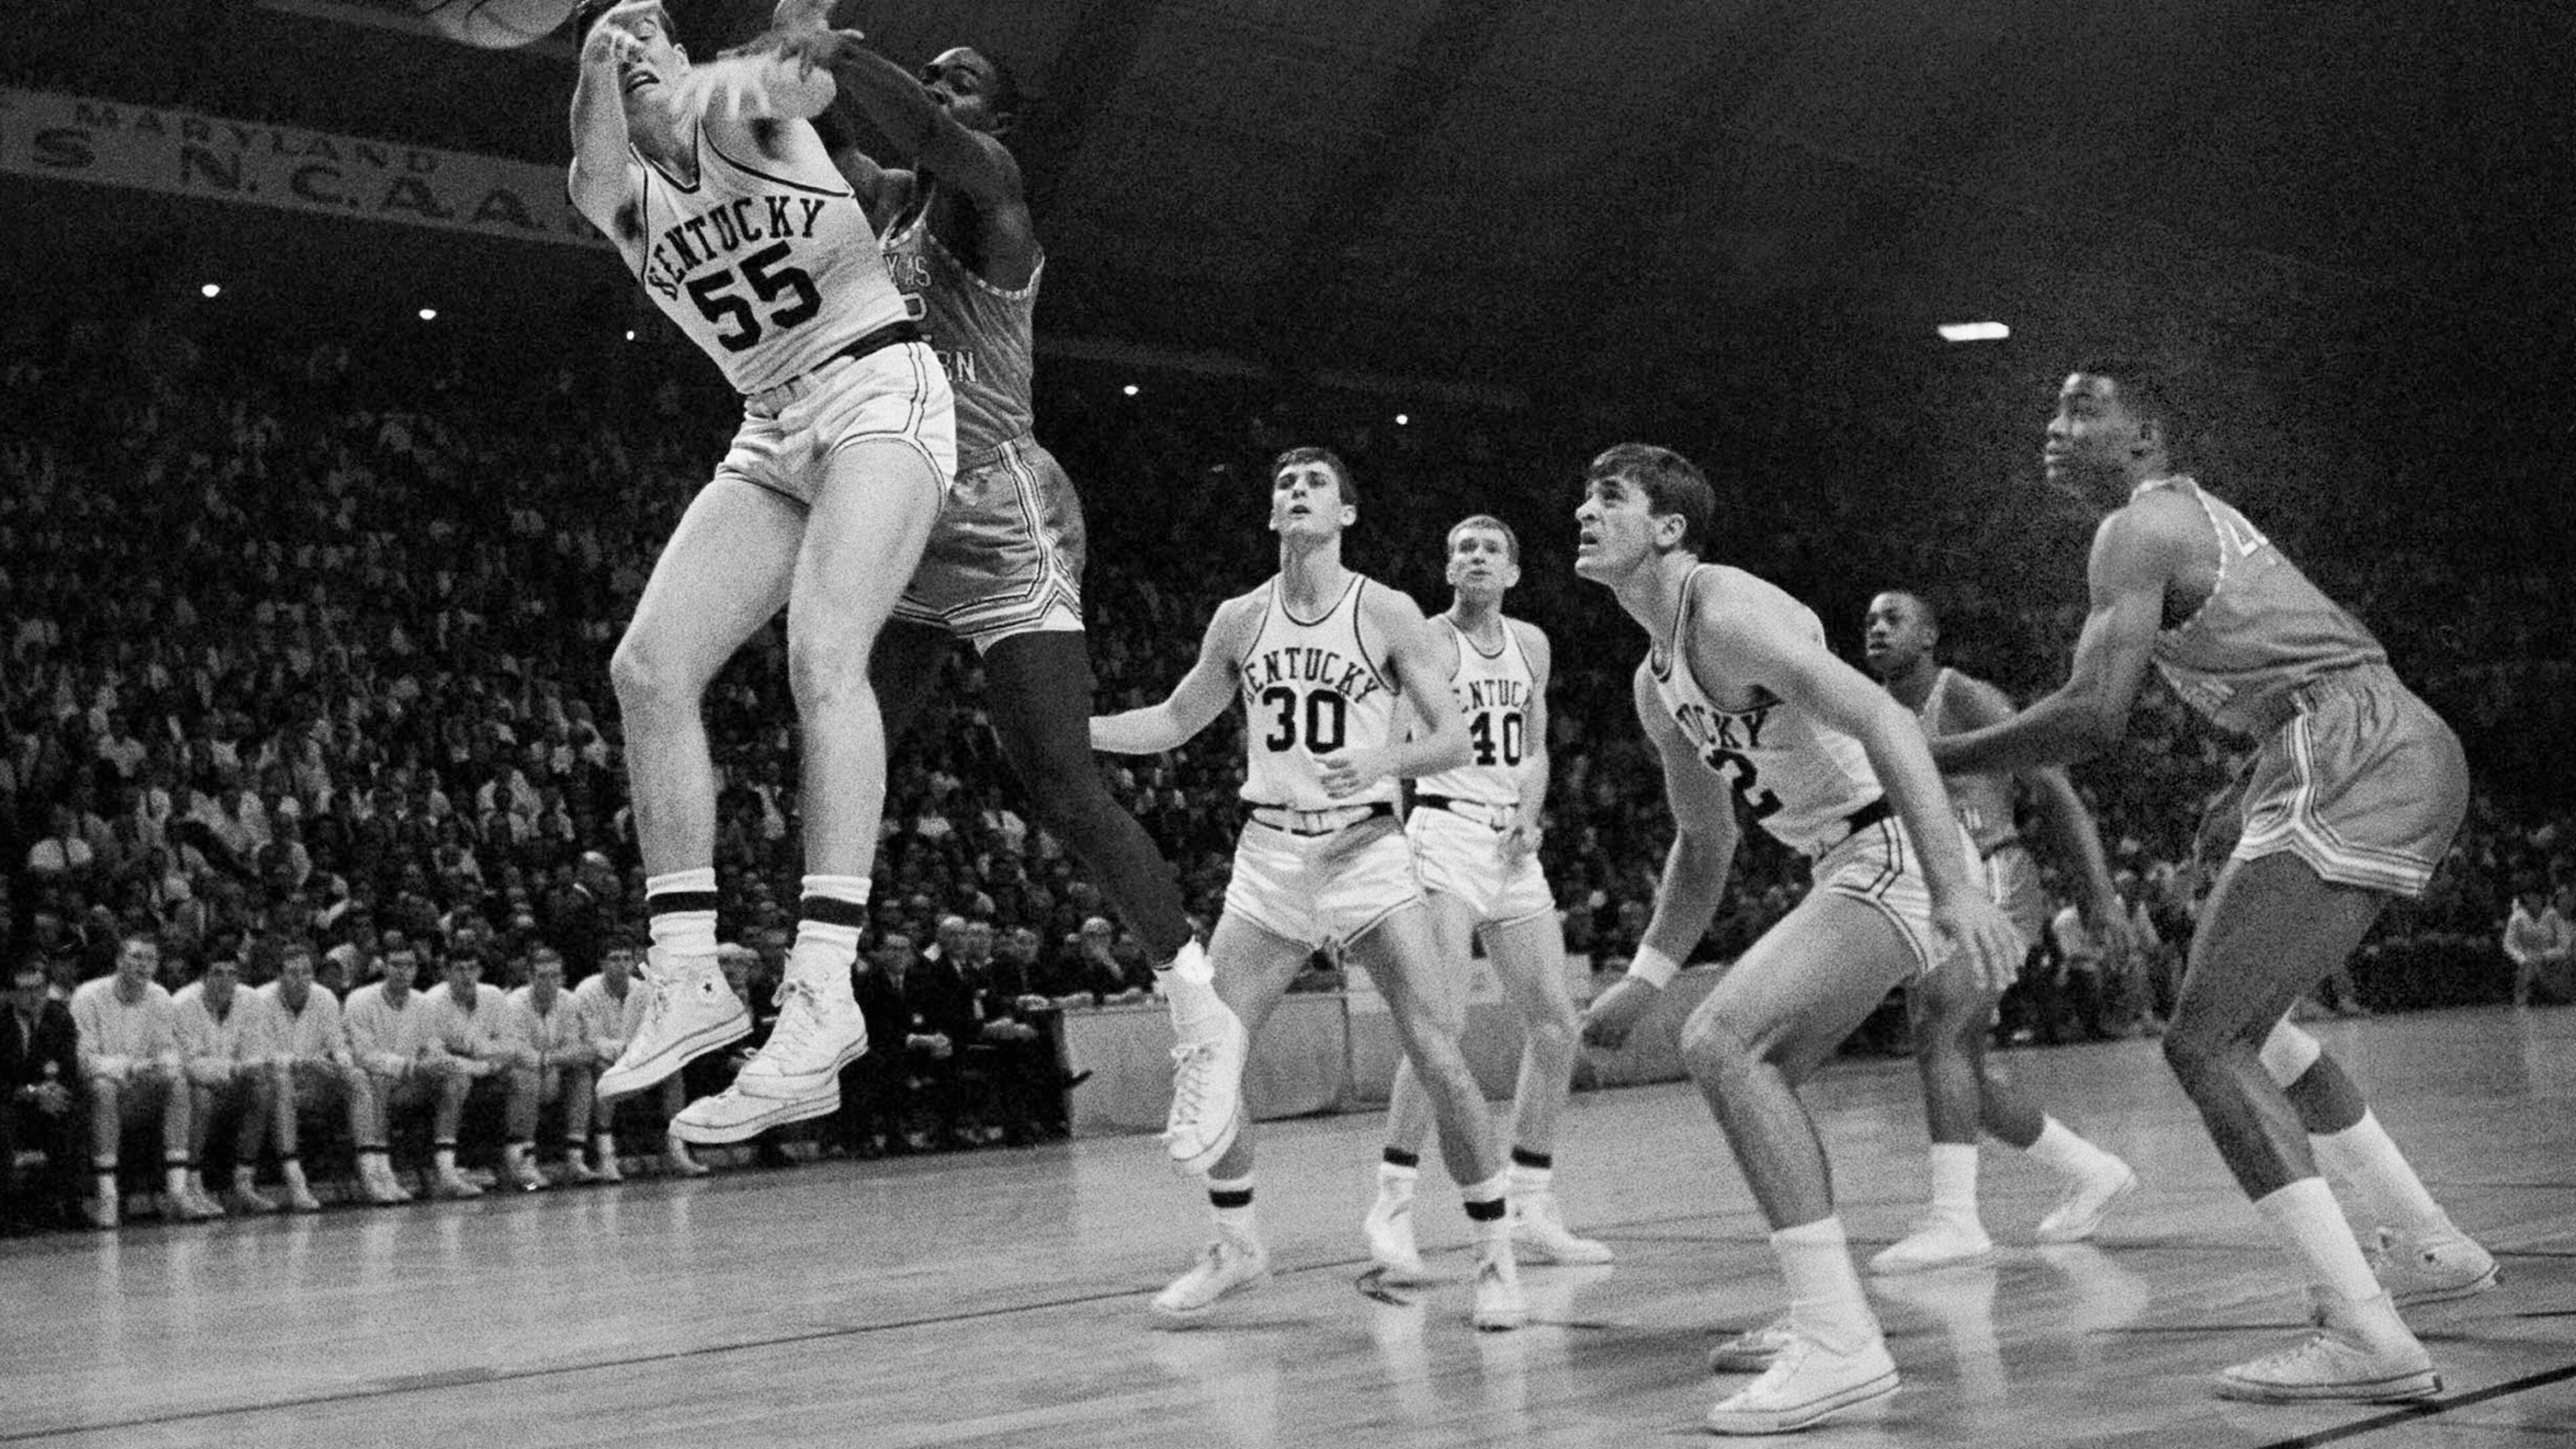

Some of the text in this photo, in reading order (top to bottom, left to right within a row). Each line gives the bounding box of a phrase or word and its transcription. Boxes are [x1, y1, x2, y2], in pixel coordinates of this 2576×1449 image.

[74, 103, 437, 173] MARYLAND
[179, 145, 547, 229] N.C.A.A.
[684, 239, 823, 353] 55
[1262, 686, 1346, 755] 30
[1469, 711, 1523, 767] 40
